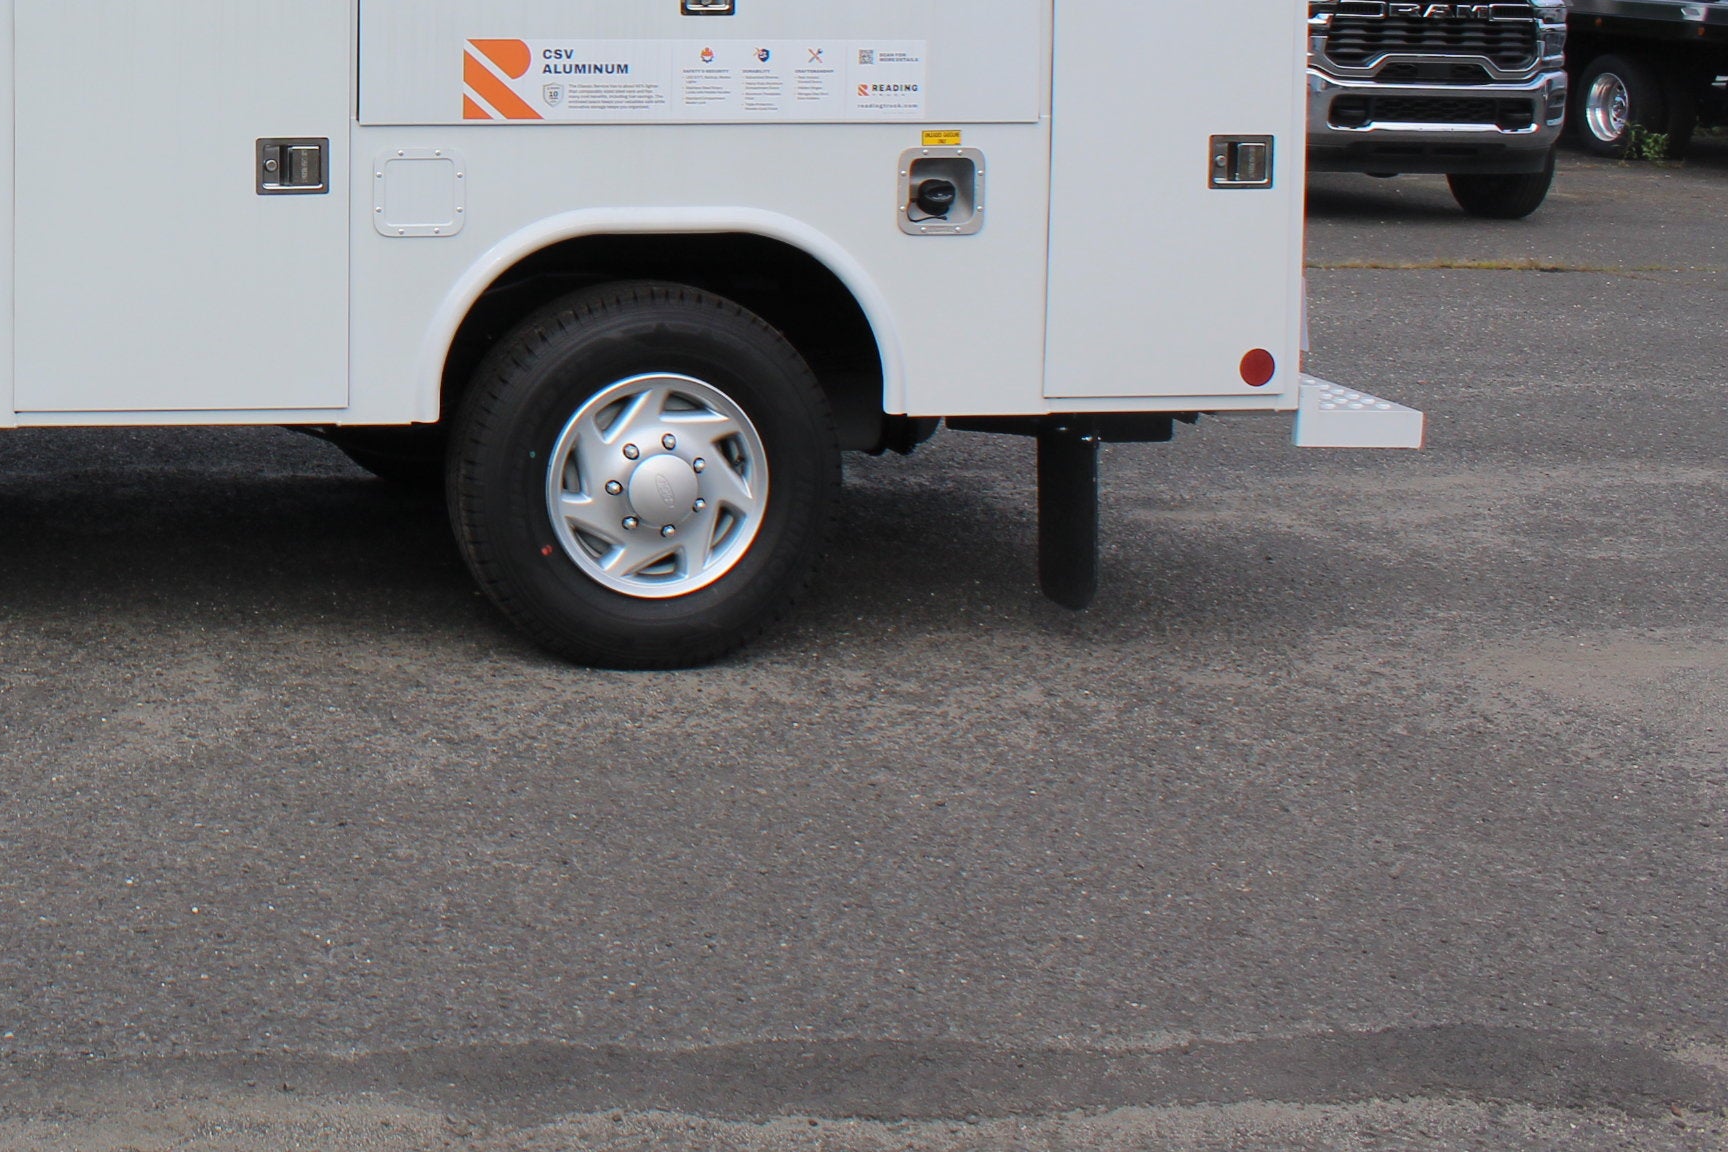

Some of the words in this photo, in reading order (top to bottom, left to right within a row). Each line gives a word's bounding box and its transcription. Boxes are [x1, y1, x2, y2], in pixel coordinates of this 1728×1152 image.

[1388, 3, 1489, 19] RAM
[542, 48, 574, 60] CSV
[542, 63, 629, 75] ALUMINUM
[872, 83, 919, 92] READING
